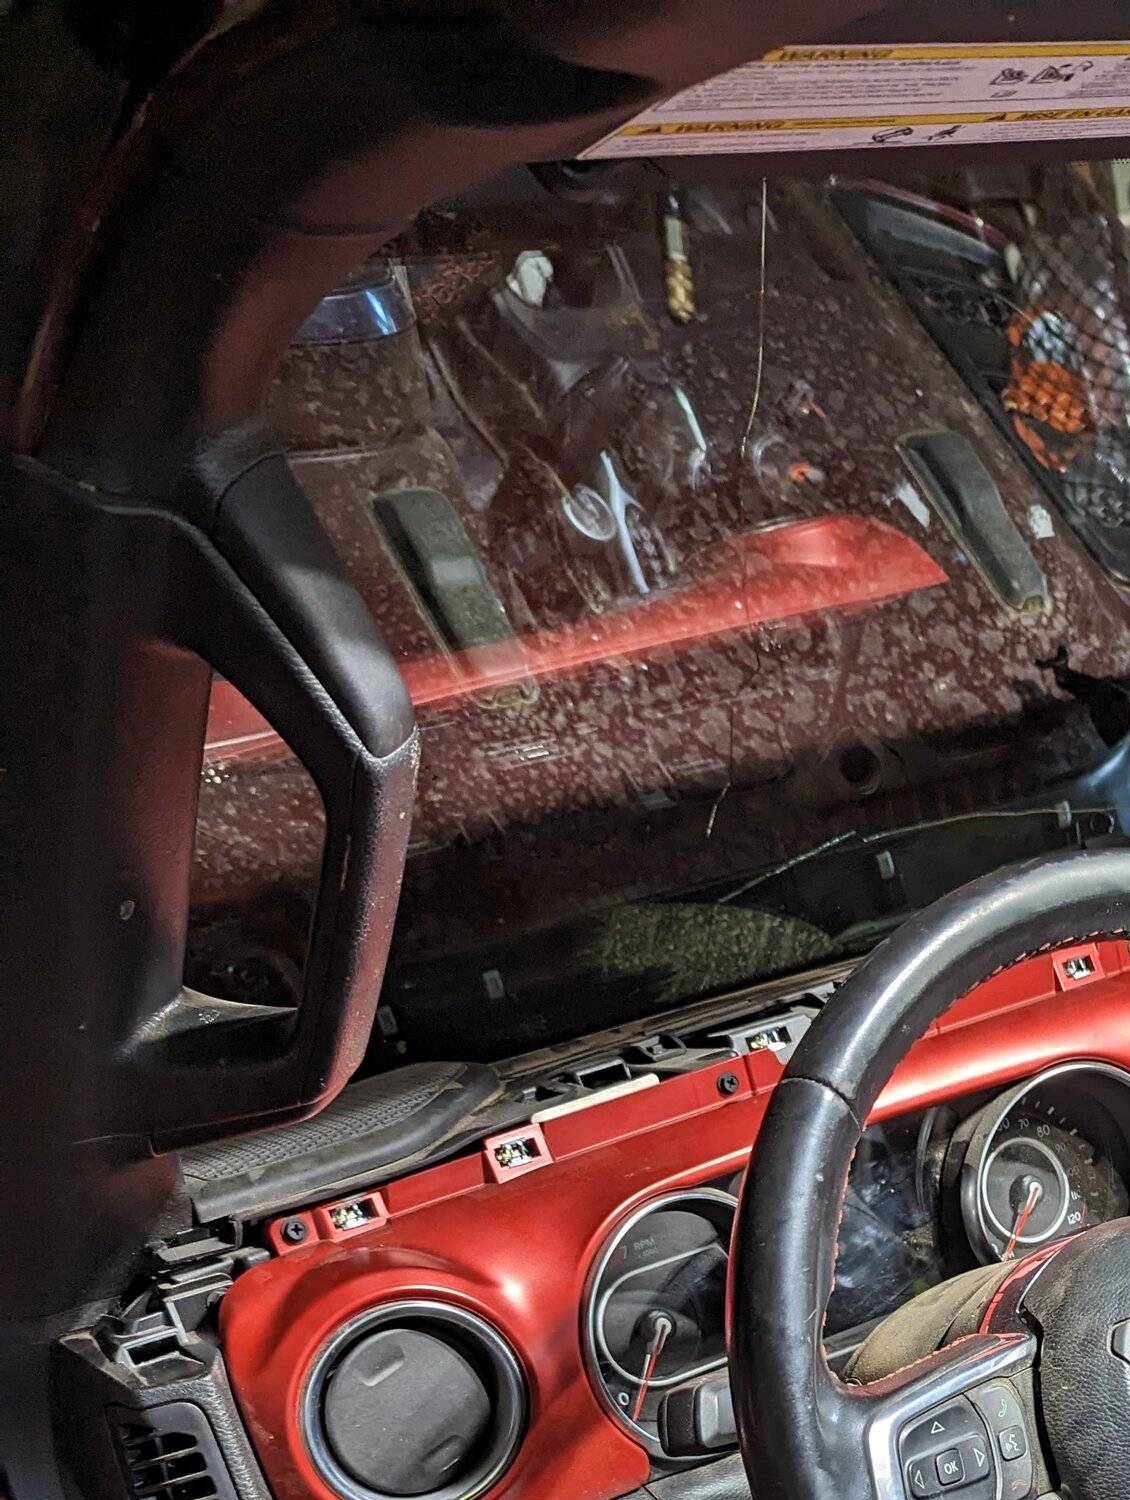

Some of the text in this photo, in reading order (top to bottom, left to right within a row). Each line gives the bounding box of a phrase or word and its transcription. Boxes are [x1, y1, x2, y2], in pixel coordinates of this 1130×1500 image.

[1018, 1118, 1030, 1130] 70
[1036, 1124, 1051, 1138] 80
[1066, 1211, 1082, 1225] 120
[944, 1461, 959, 1475] OK
